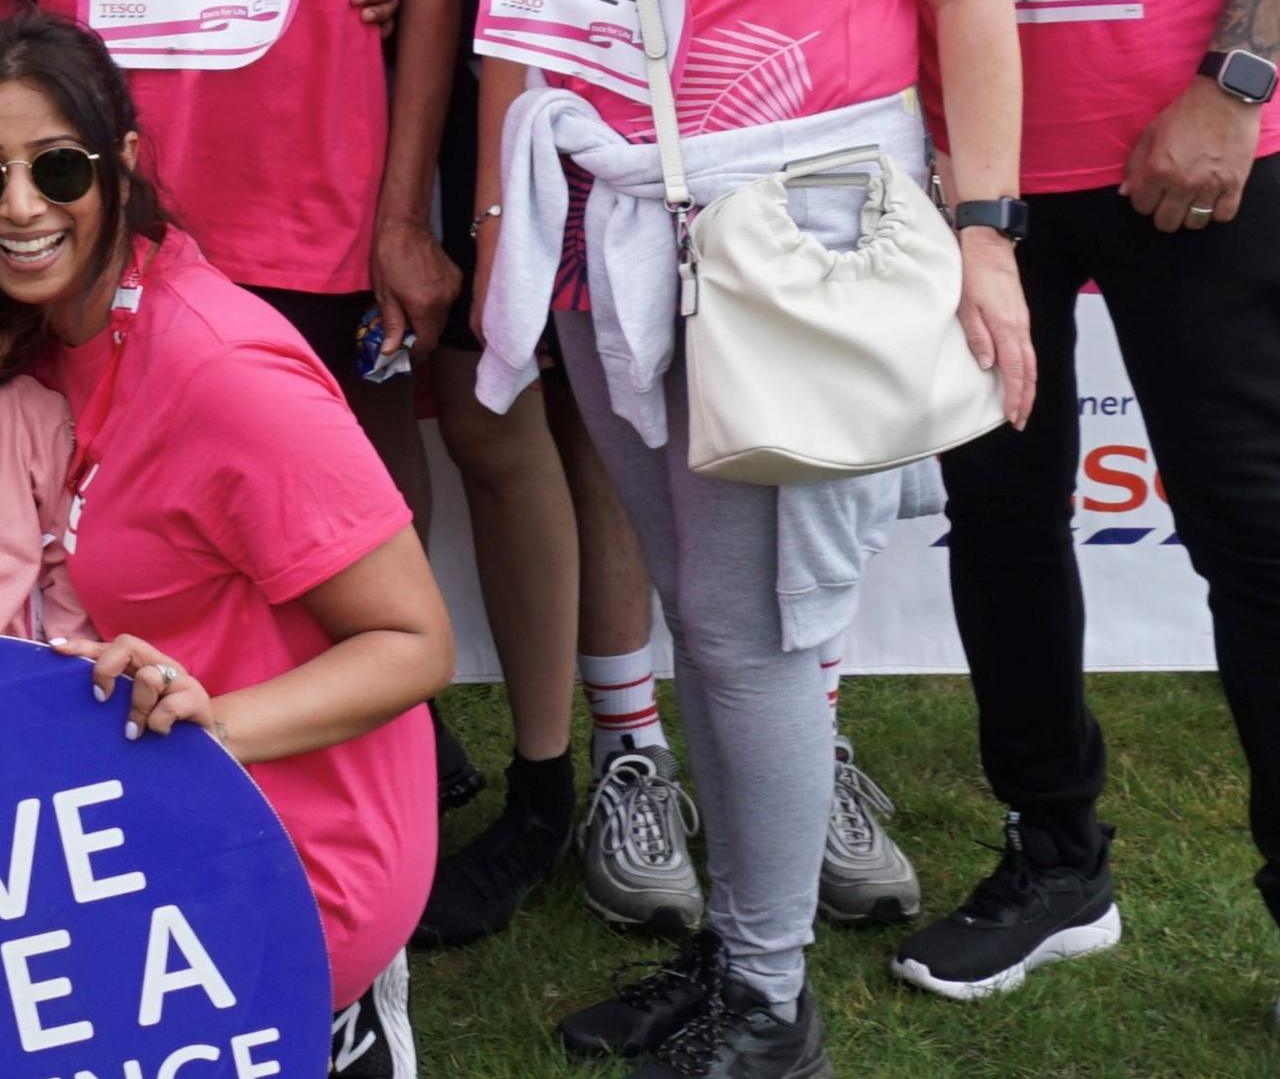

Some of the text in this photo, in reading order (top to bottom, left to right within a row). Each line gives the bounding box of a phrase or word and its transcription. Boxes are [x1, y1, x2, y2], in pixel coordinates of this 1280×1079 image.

[99, 3, 147, 14] TESCO
[1078, 393, 1135, 416] ner
[137, 903, 237, 1027] A
